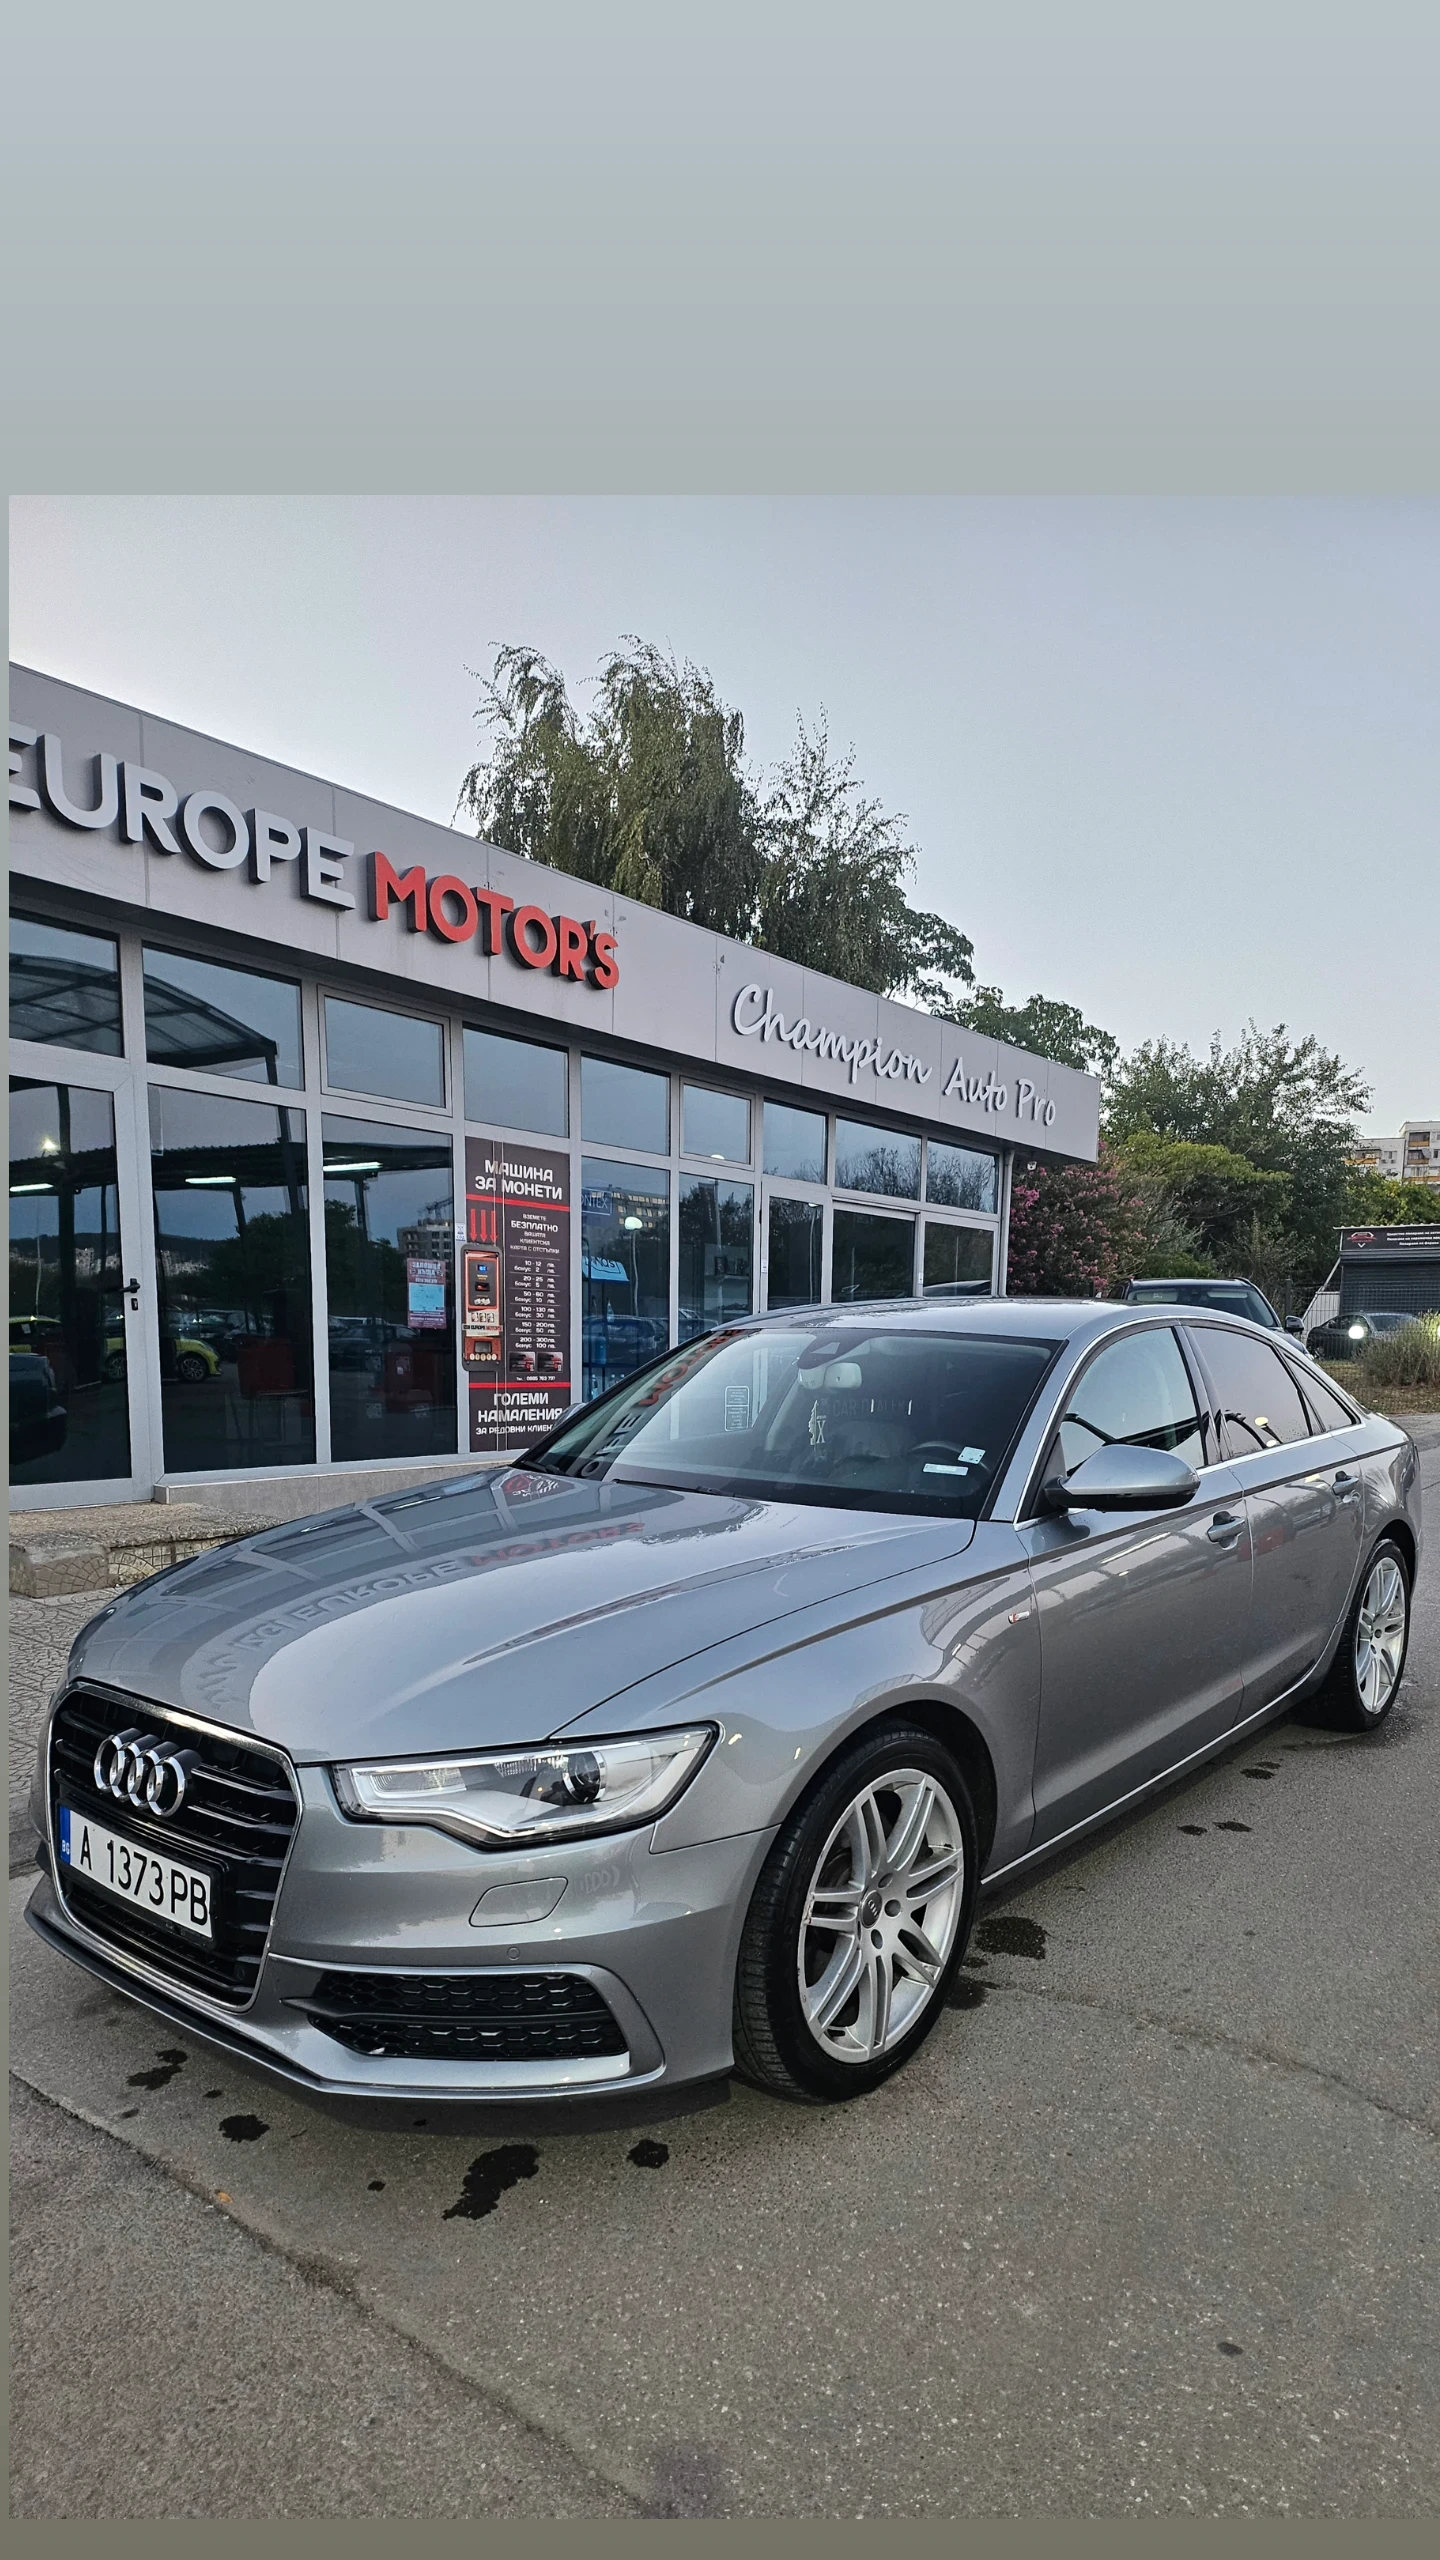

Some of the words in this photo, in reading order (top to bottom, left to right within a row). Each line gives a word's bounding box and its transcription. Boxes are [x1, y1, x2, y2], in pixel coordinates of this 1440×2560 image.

[733, 983, 933, 1084] Champion
[942, 1056, 1008, 1114] Auto
[1016, 1077, 1057, 1127] Pro
[485, 1159, 553, 1183] МАШИНА
[475, 1175, 497, 1191] ЗА
[502, 1179, 562, 1200] МОНЕТИ
[511, 1220, 558, 1232] БЕЗПЛАТНО
[494, 1392, 548, 1406] ГОЛЕМИ
[478, 1408, 562, 1423] НАМАЛЕНИЯ
[476, 1427, 487, 1435] ЗА
[489, 1426, 526, 1434] РЕДОВНИ
[528, 1424, 553, 1432] КЛИЕН
[61, 1840, 70, 1855] BG
[80, 1825, 92, 1871] A
